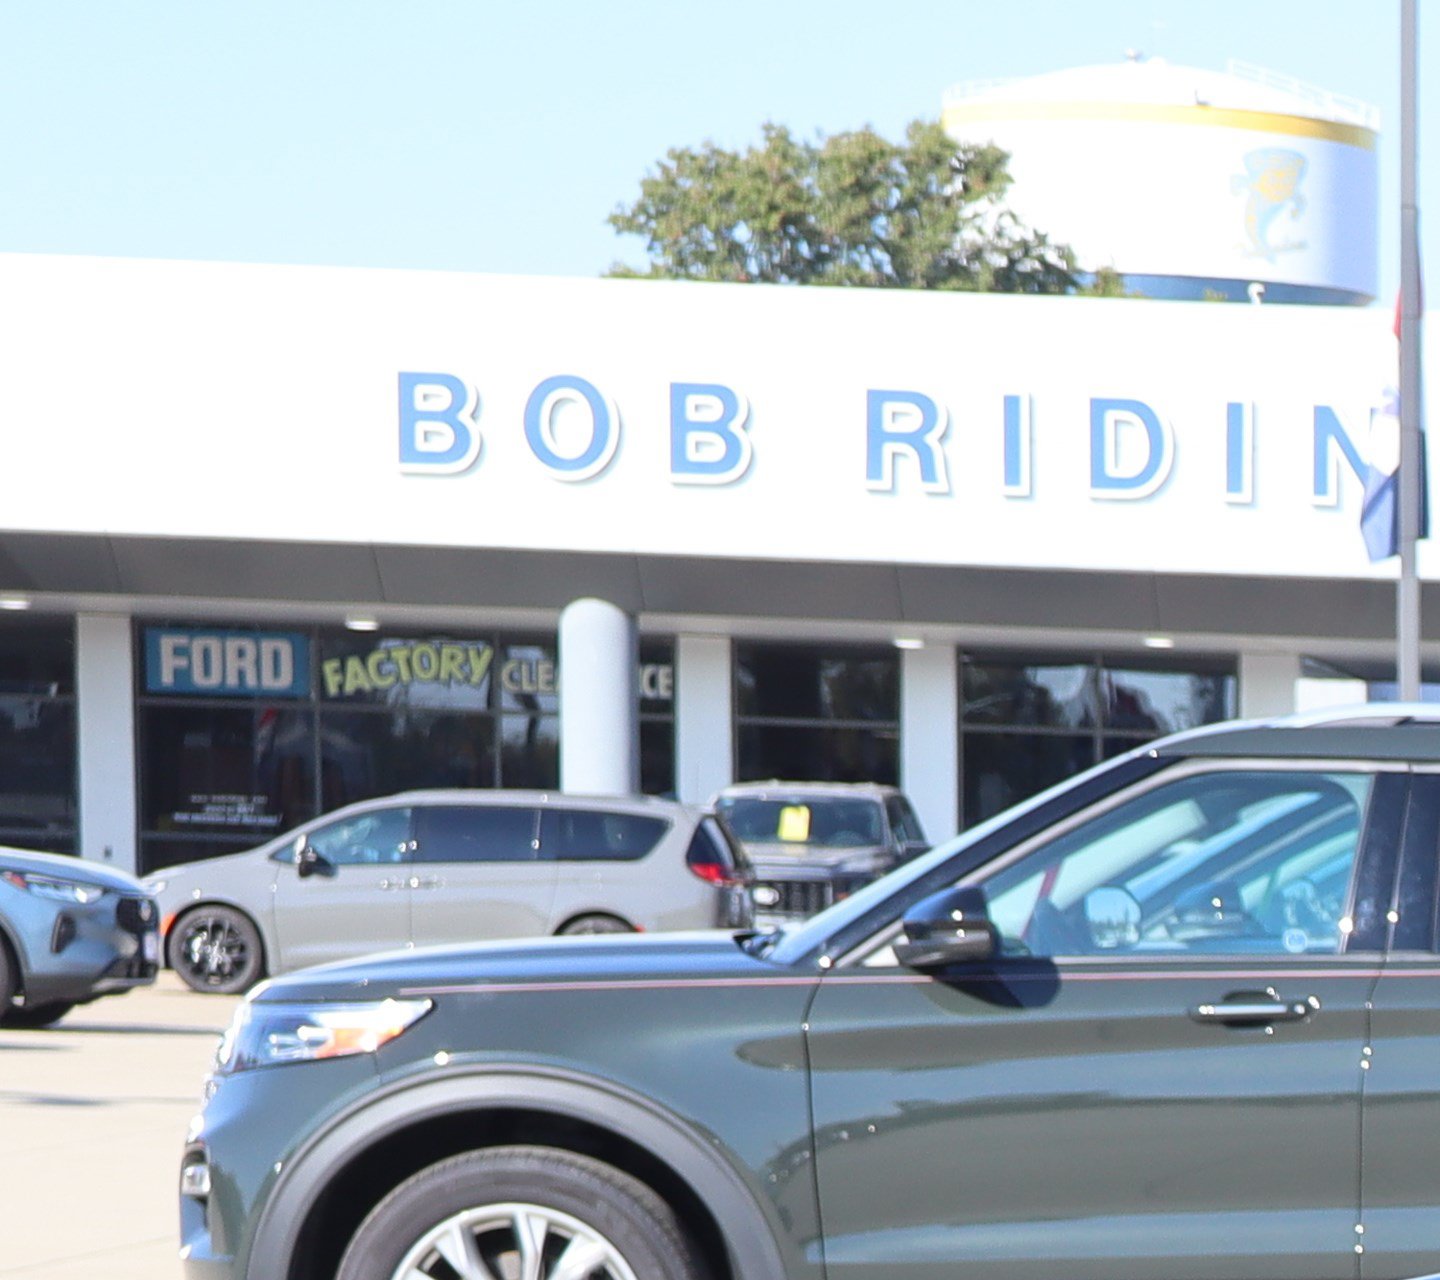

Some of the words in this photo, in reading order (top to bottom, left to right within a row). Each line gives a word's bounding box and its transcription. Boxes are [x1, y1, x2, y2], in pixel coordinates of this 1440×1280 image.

[399, 371, 753, 484] BOB
[160, 636, 293, 688] FORD
[322, 643, 496, 697] FACTORY
[501, 658, 673, 699] CLECE
